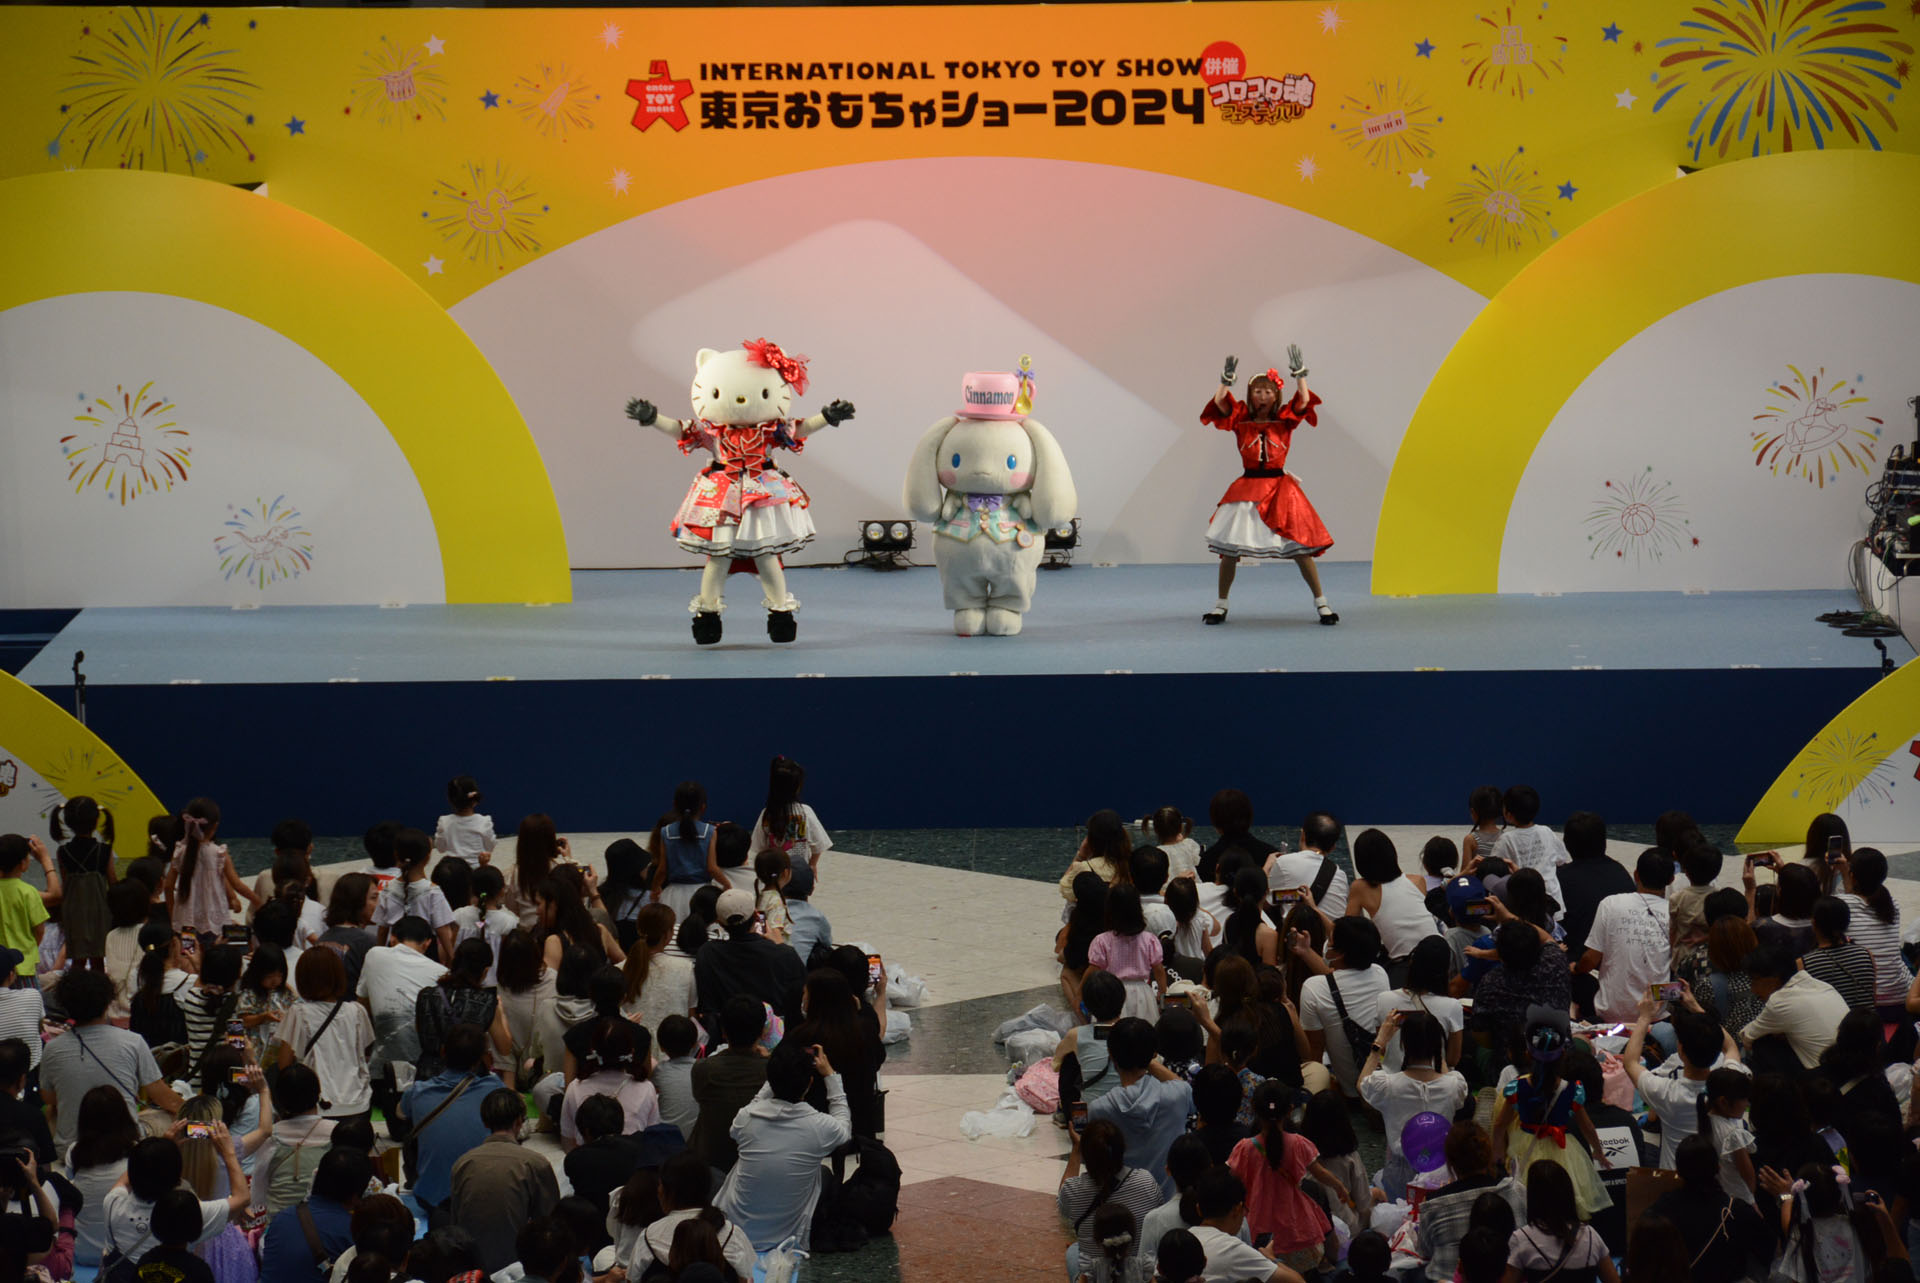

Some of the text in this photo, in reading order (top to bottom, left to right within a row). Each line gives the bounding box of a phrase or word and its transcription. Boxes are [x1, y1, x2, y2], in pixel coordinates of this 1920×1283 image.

[700, 57, 1204, 81] INTERNATIONAL TOKYO TOY SHOW
[645, 84, 676, 92] enter
[1209, 74, 1314, 108] コロコロ魂
[645, 93, 676, 105] TOY
[646, 105, 675, 113] ment
[700, 88, 1205, 129] 東京おもちゃショー2024
[965, 385, 1015, 405] Cinnamon
